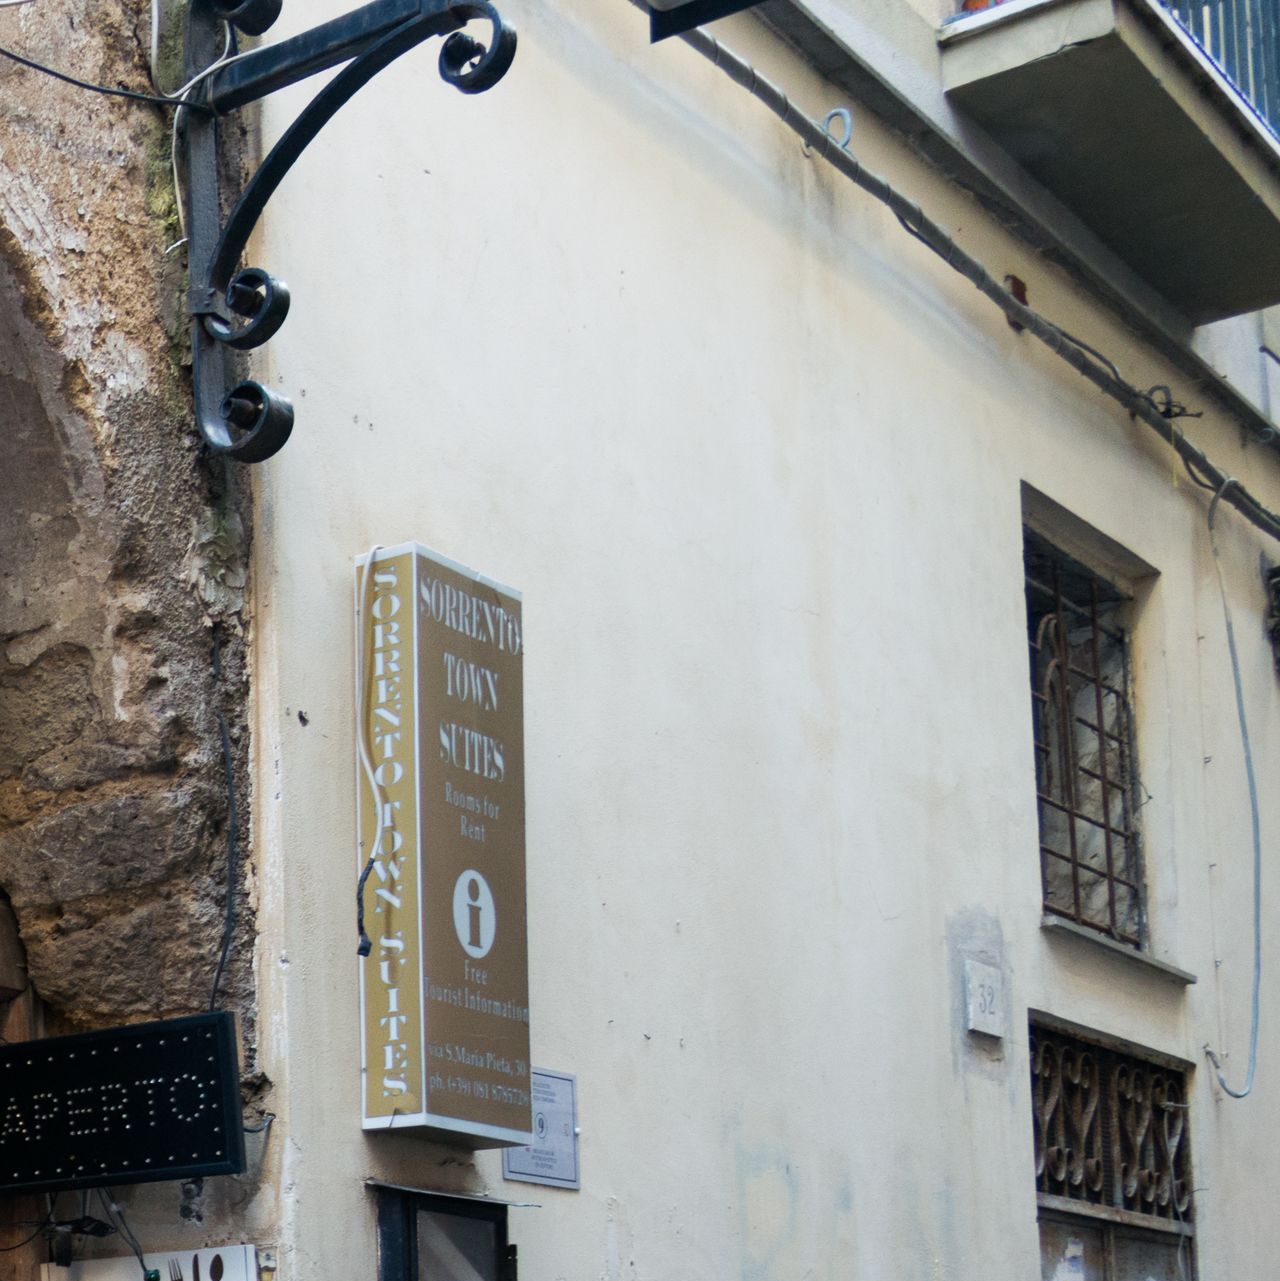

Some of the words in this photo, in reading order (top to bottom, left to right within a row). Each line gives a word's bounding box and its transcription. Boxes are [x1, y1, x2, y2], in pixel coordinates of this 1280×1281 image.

[420, 577, 522, 655] SORRENTO
[371, 564, 404, 787] SORRENTO
[443, 652, 499, 712] TOWN
[439, 722, 505, 783] SUITES
[444, 782, 481, 814] Rooms
[483, 795, 500, 820] for
[460, 815, 486, 842] Rent
[373, 800, 406, 913] TOWN
[423, 976, 462, 1006] Tourist
[464, 959, 488, 985] Free
[978, 983, 996, 1016] 32
[379, 931, 408, 1097] SUITES
[0, 1073, 207, 1145] APERTO
